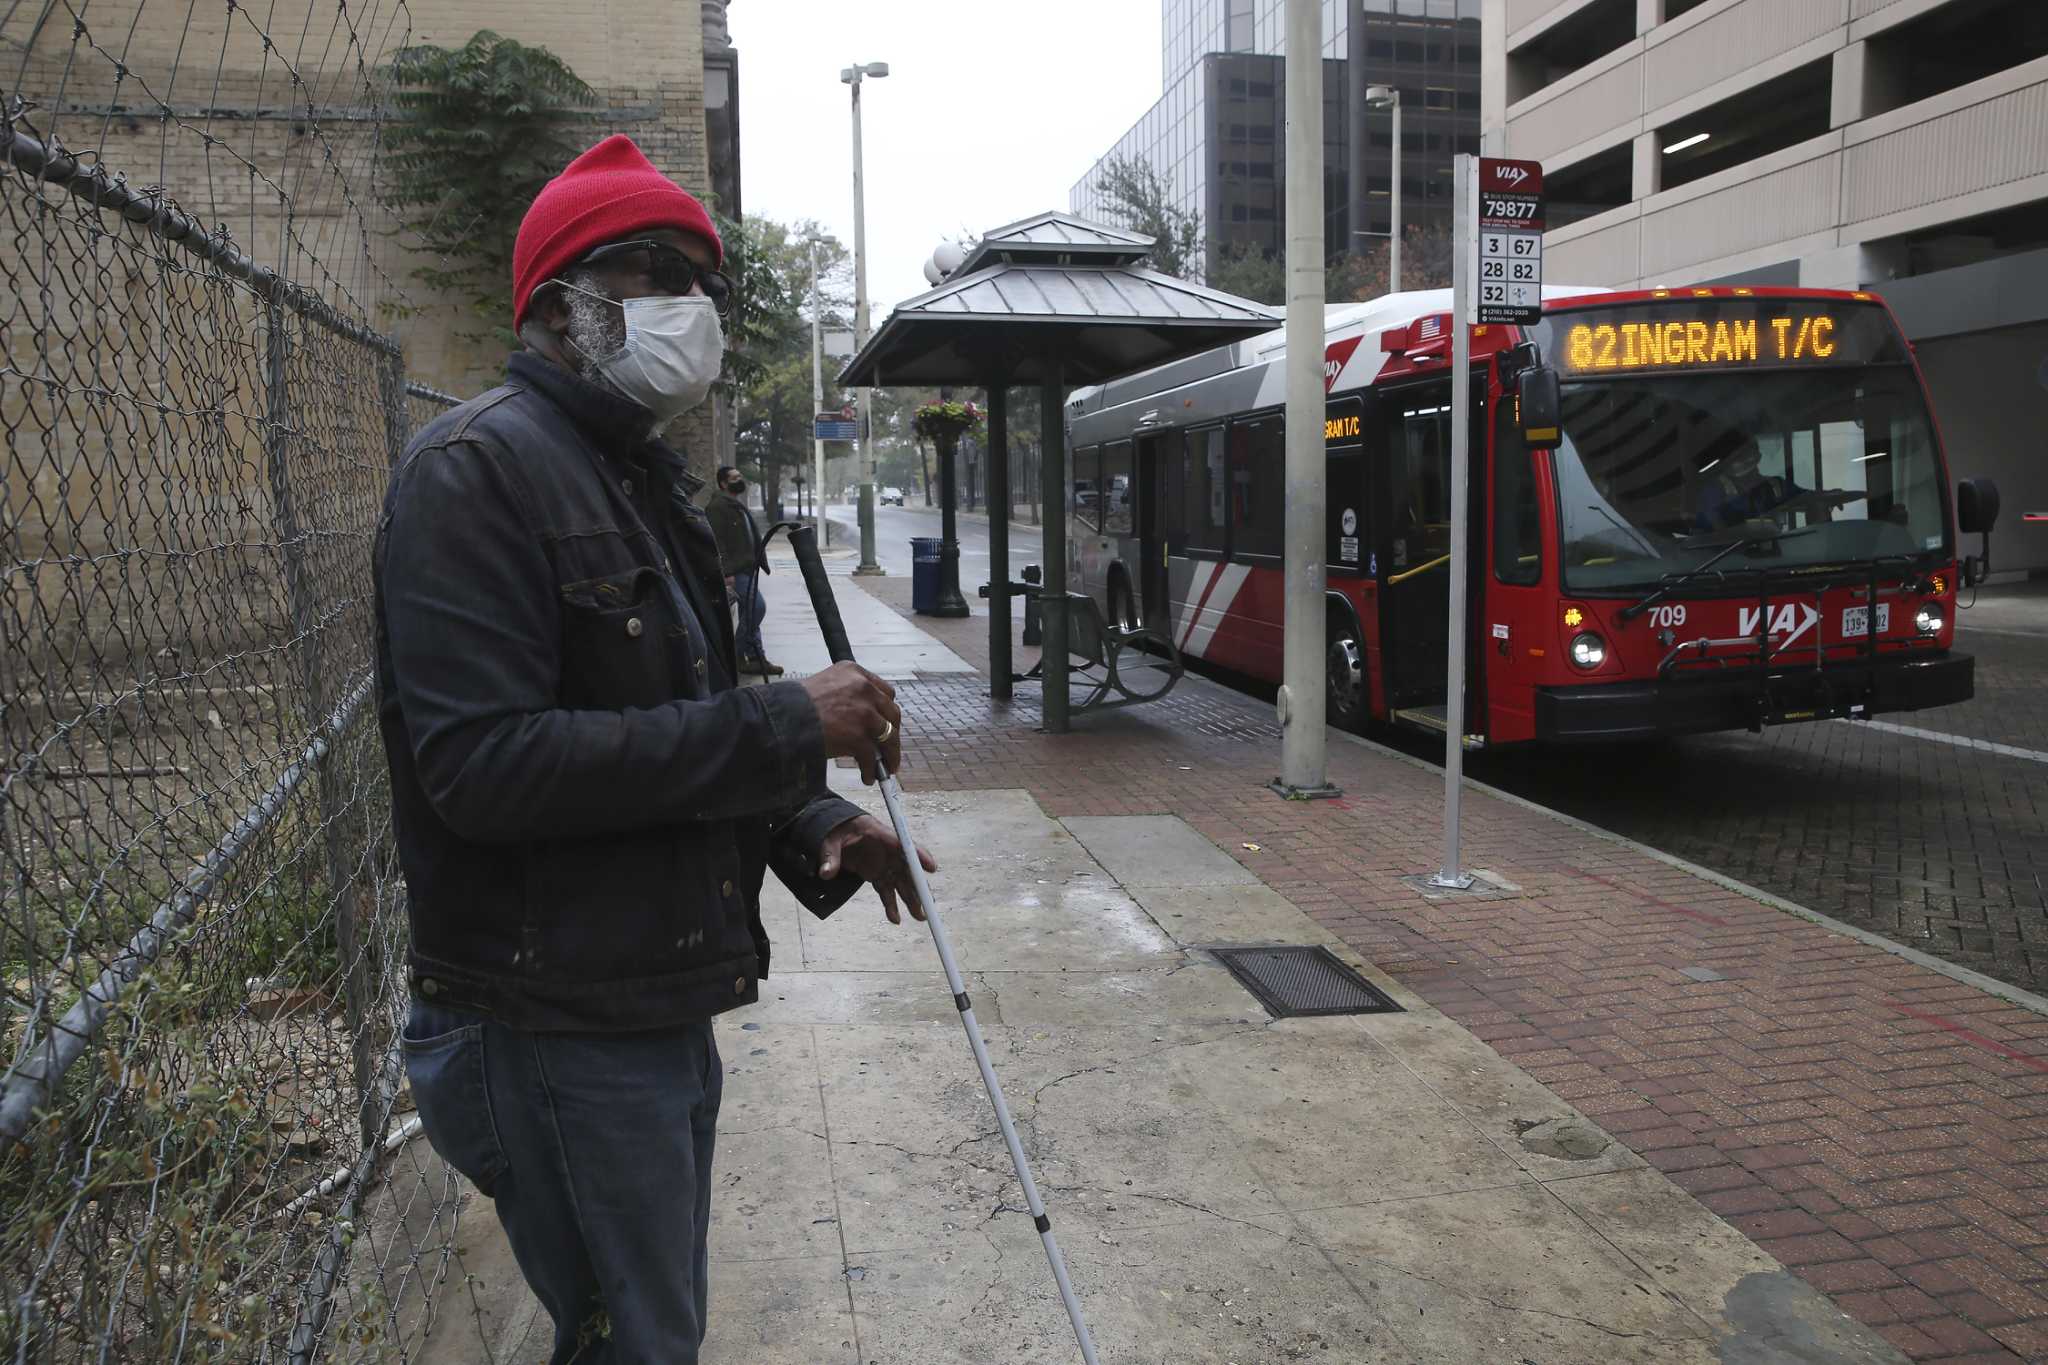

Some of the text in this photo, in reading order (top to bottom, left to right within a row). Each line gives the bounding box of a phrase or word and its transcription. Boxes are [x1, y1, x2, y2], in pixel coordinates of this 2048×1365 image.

[1496, 166, 1518, 179] VIA
[1486, 200, 1537, 219] 79877
[1489, 238, 1499, 253] 3
[1514, 239, 1535, 255] 67
[1484, 262, 1504, 278] 28
[1513, 264, 1533, 279] 82
[1484, 286, 1504, 301] 32
[1771, 317, 1834, 360] T/C
[1344, 416, 1360, 436] T/C
[1648, 604, 1686, 629] 709
[1739, 603, 1796, 637] VIA
